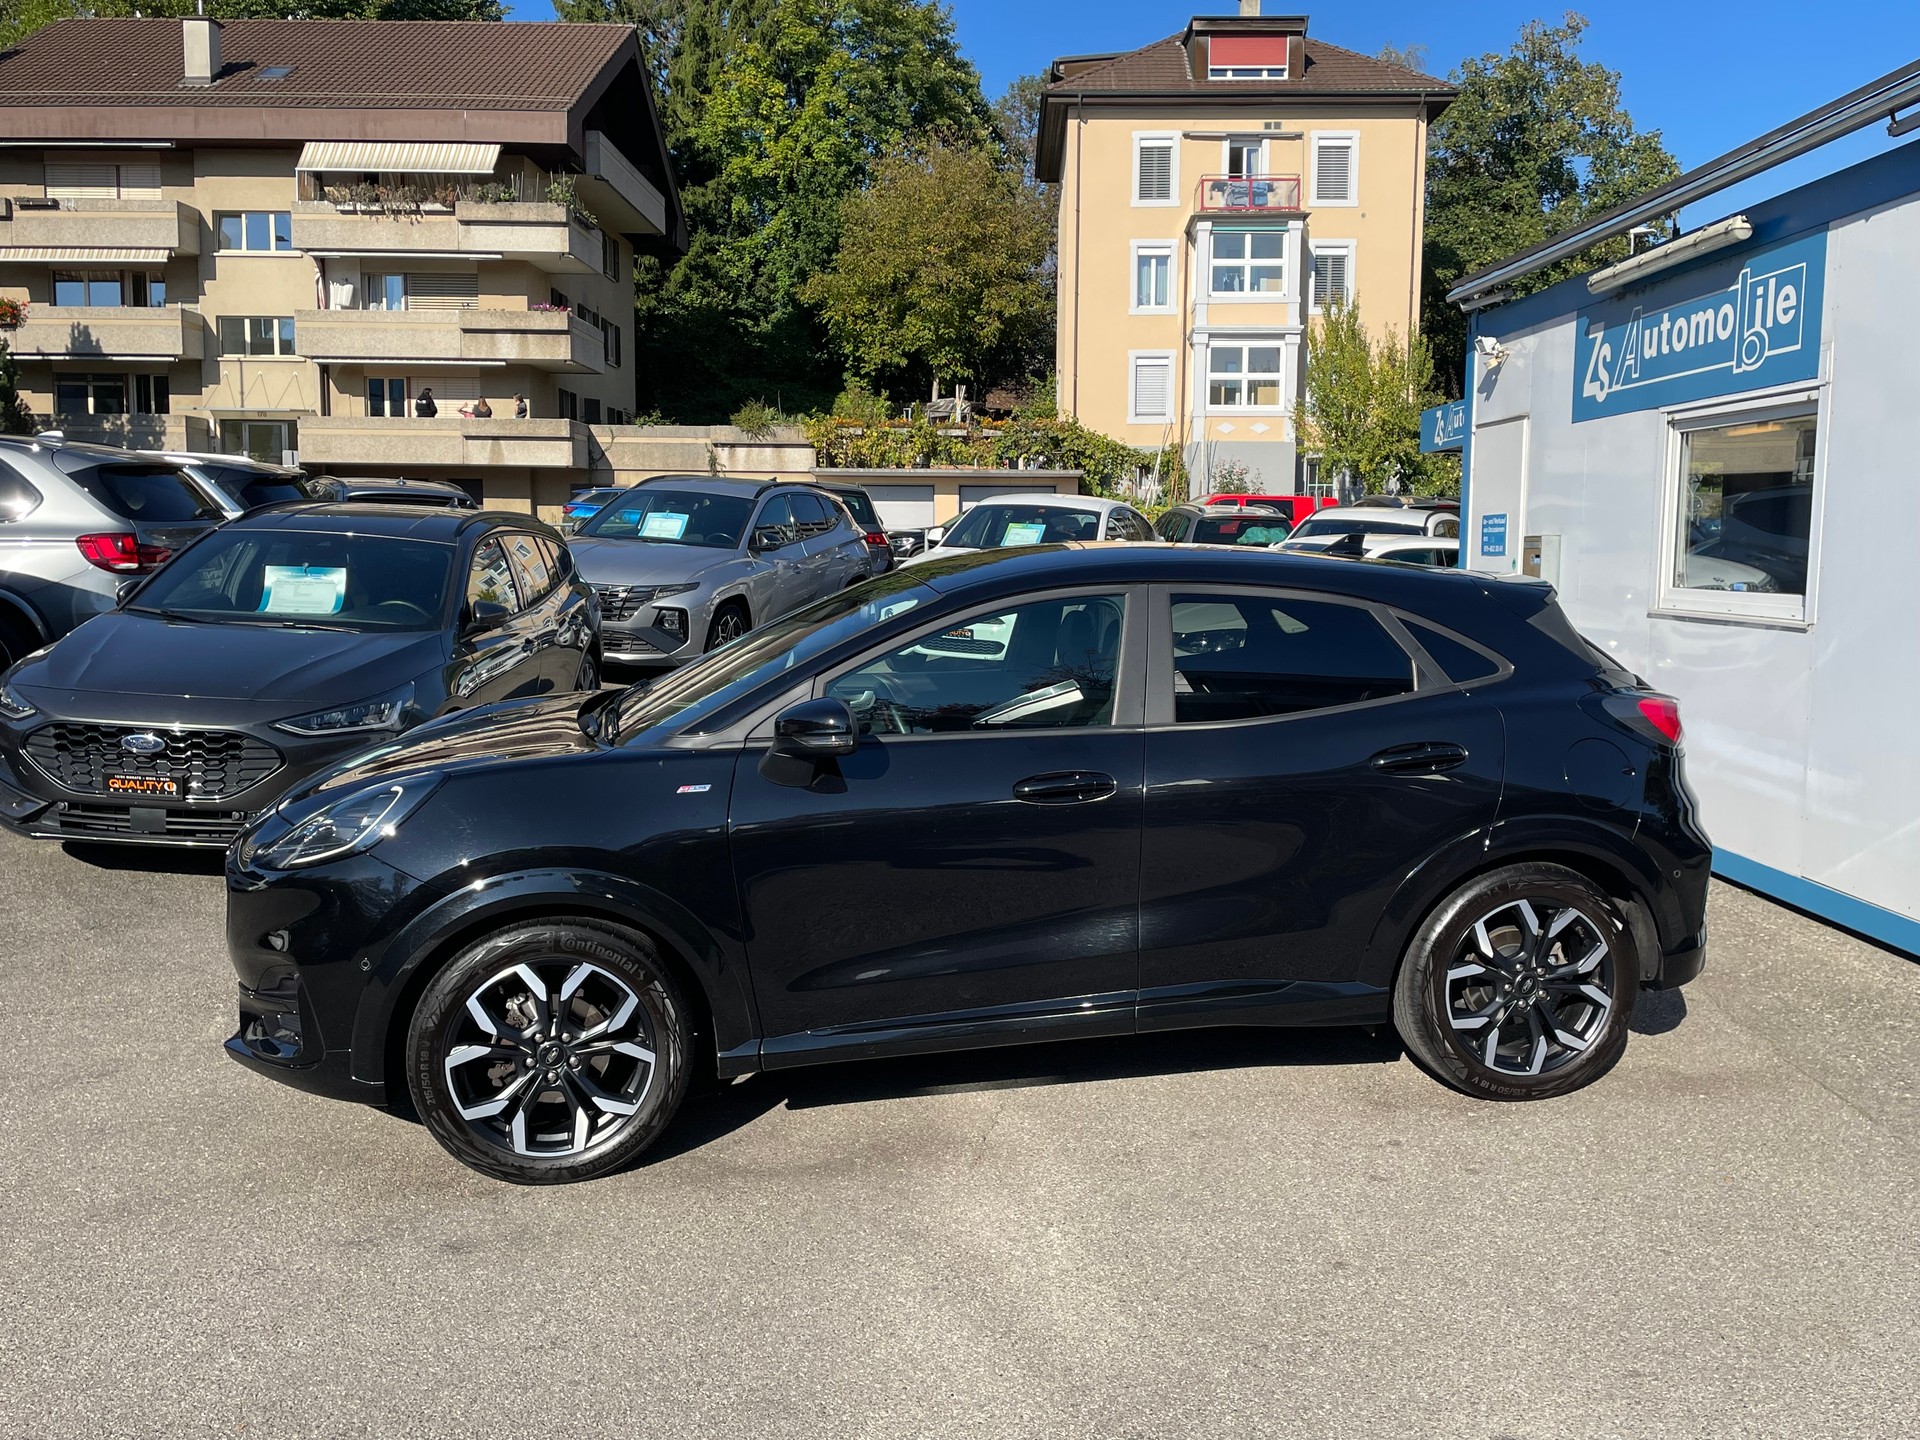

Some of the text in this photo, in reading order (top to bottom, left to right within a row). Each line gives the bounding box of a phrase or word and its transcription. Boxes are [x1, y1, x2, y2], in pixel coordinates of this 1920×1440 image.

[1612, 268, 1797, 391] Automobile
[108, 778, 163, 791] QUALITY
[560, 936, 639, 974] Continental
[420, 1072, 436, 1106] 215/50
